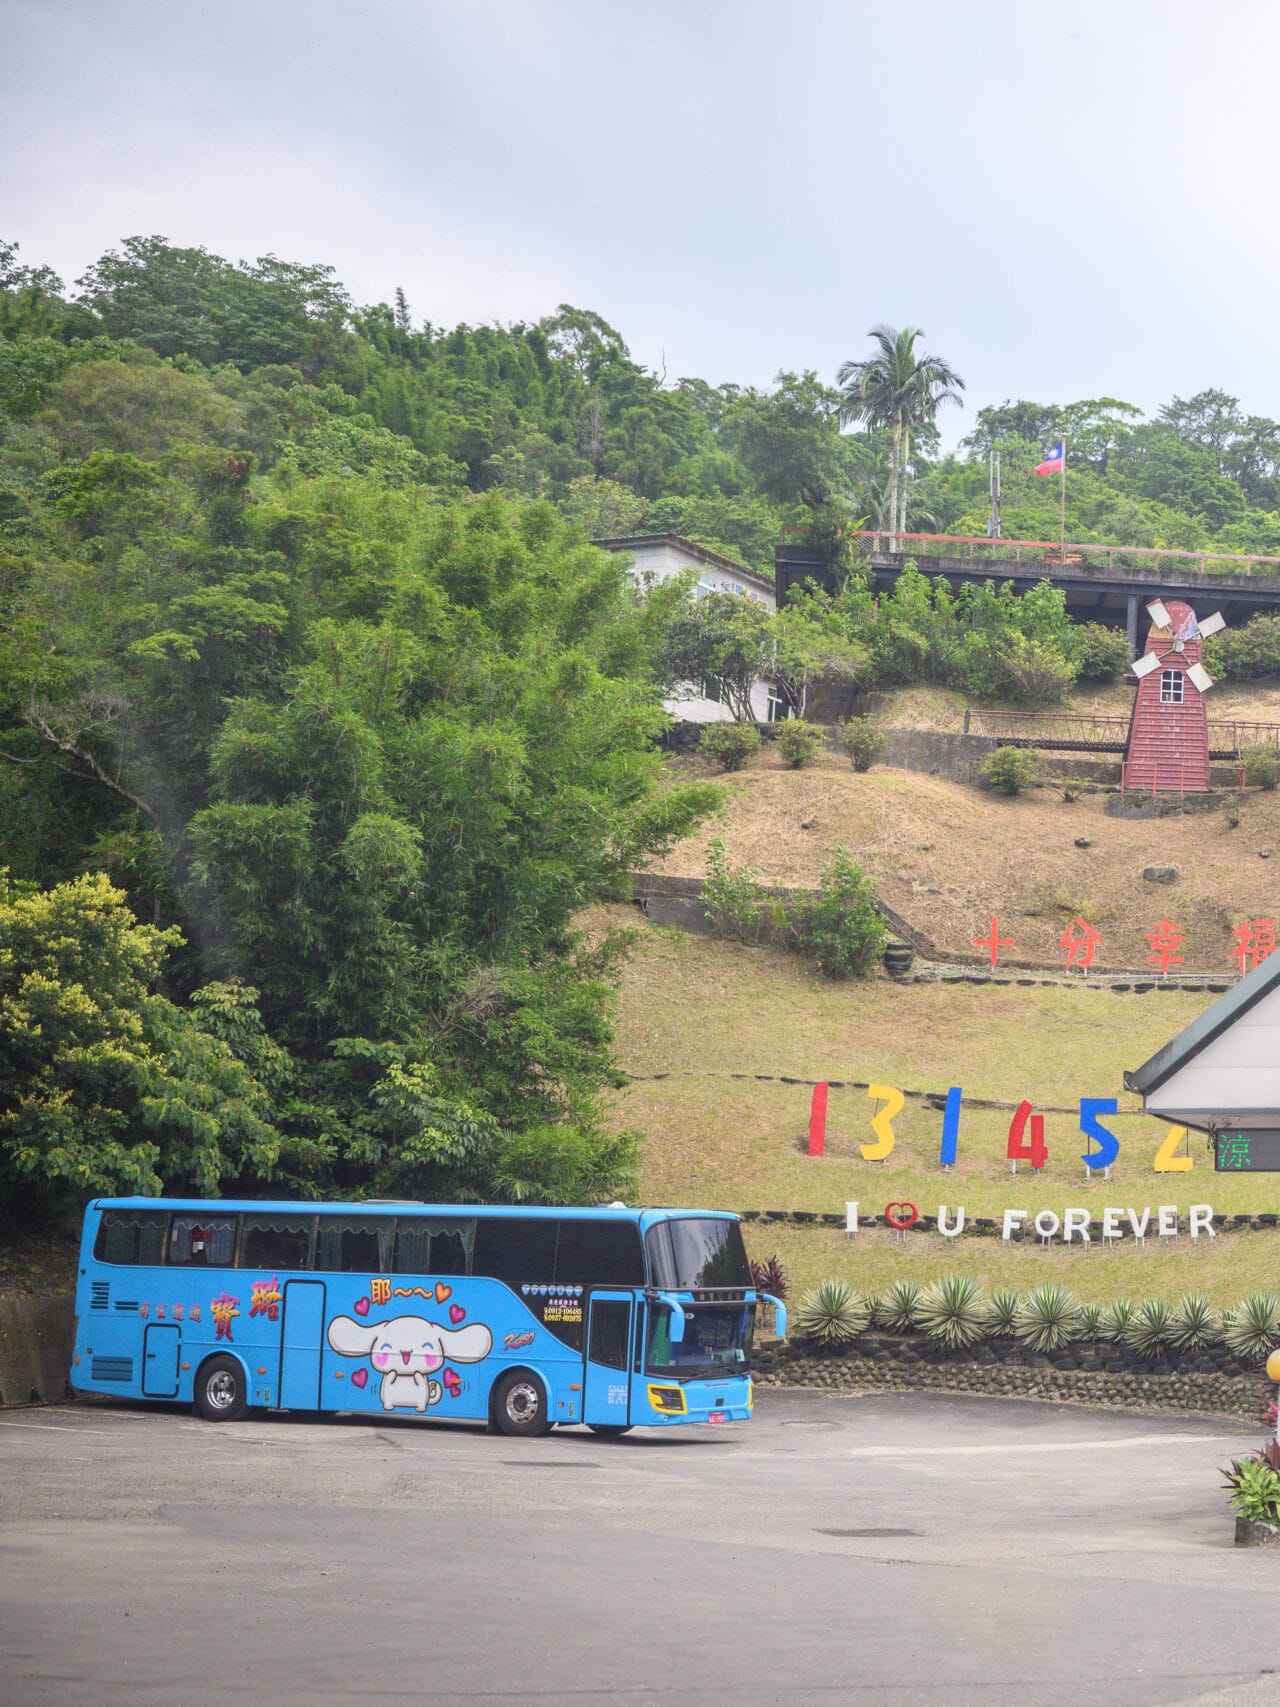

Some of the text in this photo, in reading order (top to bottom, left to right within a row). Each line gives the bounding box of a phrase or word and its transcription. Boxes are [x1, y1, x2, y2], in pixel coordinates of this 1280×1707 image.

[974, 915, 1278, 974] 十分幸福
[845, 1202, 1217, 1242] I U FOREVER
